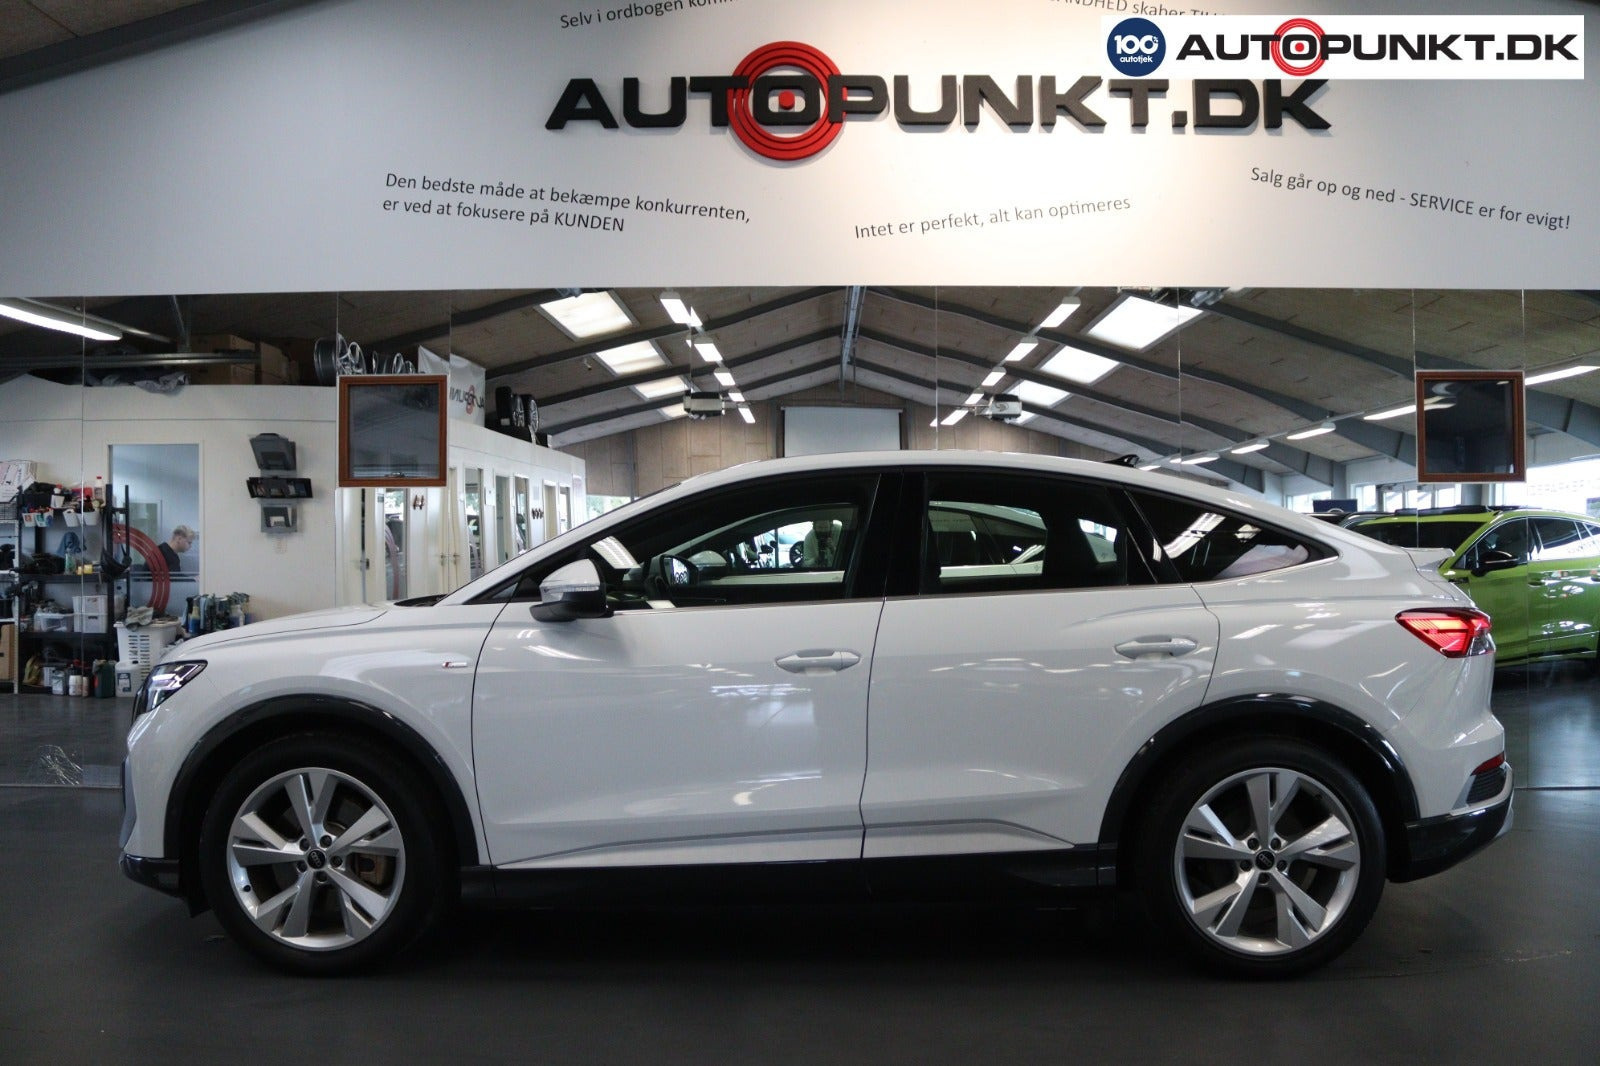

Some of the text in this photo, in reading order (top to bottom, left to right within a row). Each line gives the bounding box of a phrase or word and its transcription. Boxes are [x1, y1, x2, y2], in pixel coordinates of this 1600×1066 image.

[560, 11, 593, 29] Selv
[597, 9, 602, 23] i
[606, 0, 684, 21] ordbogen
[545, 74, 1332, 130] AUTOPUNKT.DK
[382, 199, 625, 232] er ved at fokusere på KUNDEN
[385, 173, 750, 224] Den bedste måde at bekæmpe konkurrenten,
[855, 198, 1131, 239] Intet er perfekt, alt kan optimeres
[1250, 167, 1284, 188] Salg
[1286, 173, 1313, 191] går
[1316, 180, 1337, 196] op
[1341, 184, 1361, 201] og
[1365, 188, 1396, 203] ned
[1409, 192, 1475, 216] SERVICE
[1478, 206, 1496, 218] er
[1499, 205, 1523, 222] for
[1526, 213, 1570, 231] evigt!
